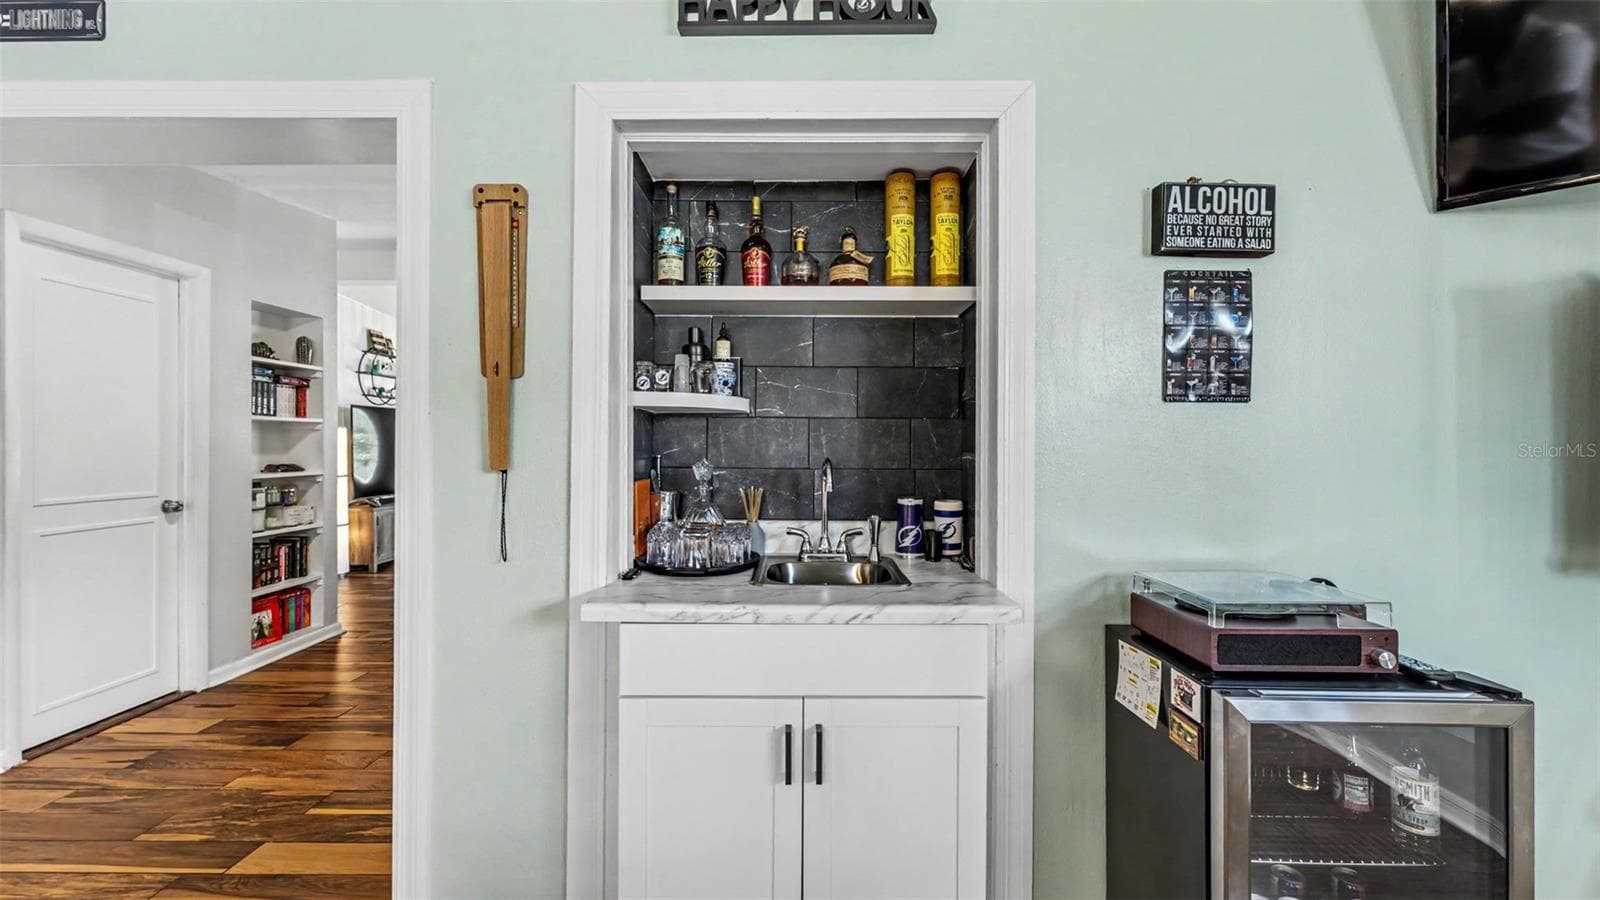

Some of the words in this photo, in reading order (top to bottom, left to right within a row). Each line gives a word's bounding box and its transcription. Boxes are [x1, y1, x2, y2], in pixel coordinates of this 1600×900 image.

[9, 9, 83, 30] LIGHTNING
[1168, 186, 1273, 215] ALCOHOL
[1167, 214, 1204, 225] BECAUSE
[1205, 215, 1217, 225] NO
[1218, 215, 1244, 226] GREAT
[1246, 216, 1272, 227] STORY
[1167, 225, 1192, 236] EVER
[1197, 226, 1242, 237] STARTED
[1246, 227, 1272, 238] WITH
[1166, 236, 1205, 248] SOMEONE
[1207, 237, 1236, 248] EATING
[1238, 238, 1244, 249] A
[1245, 238, 1272, 249] SALAD
